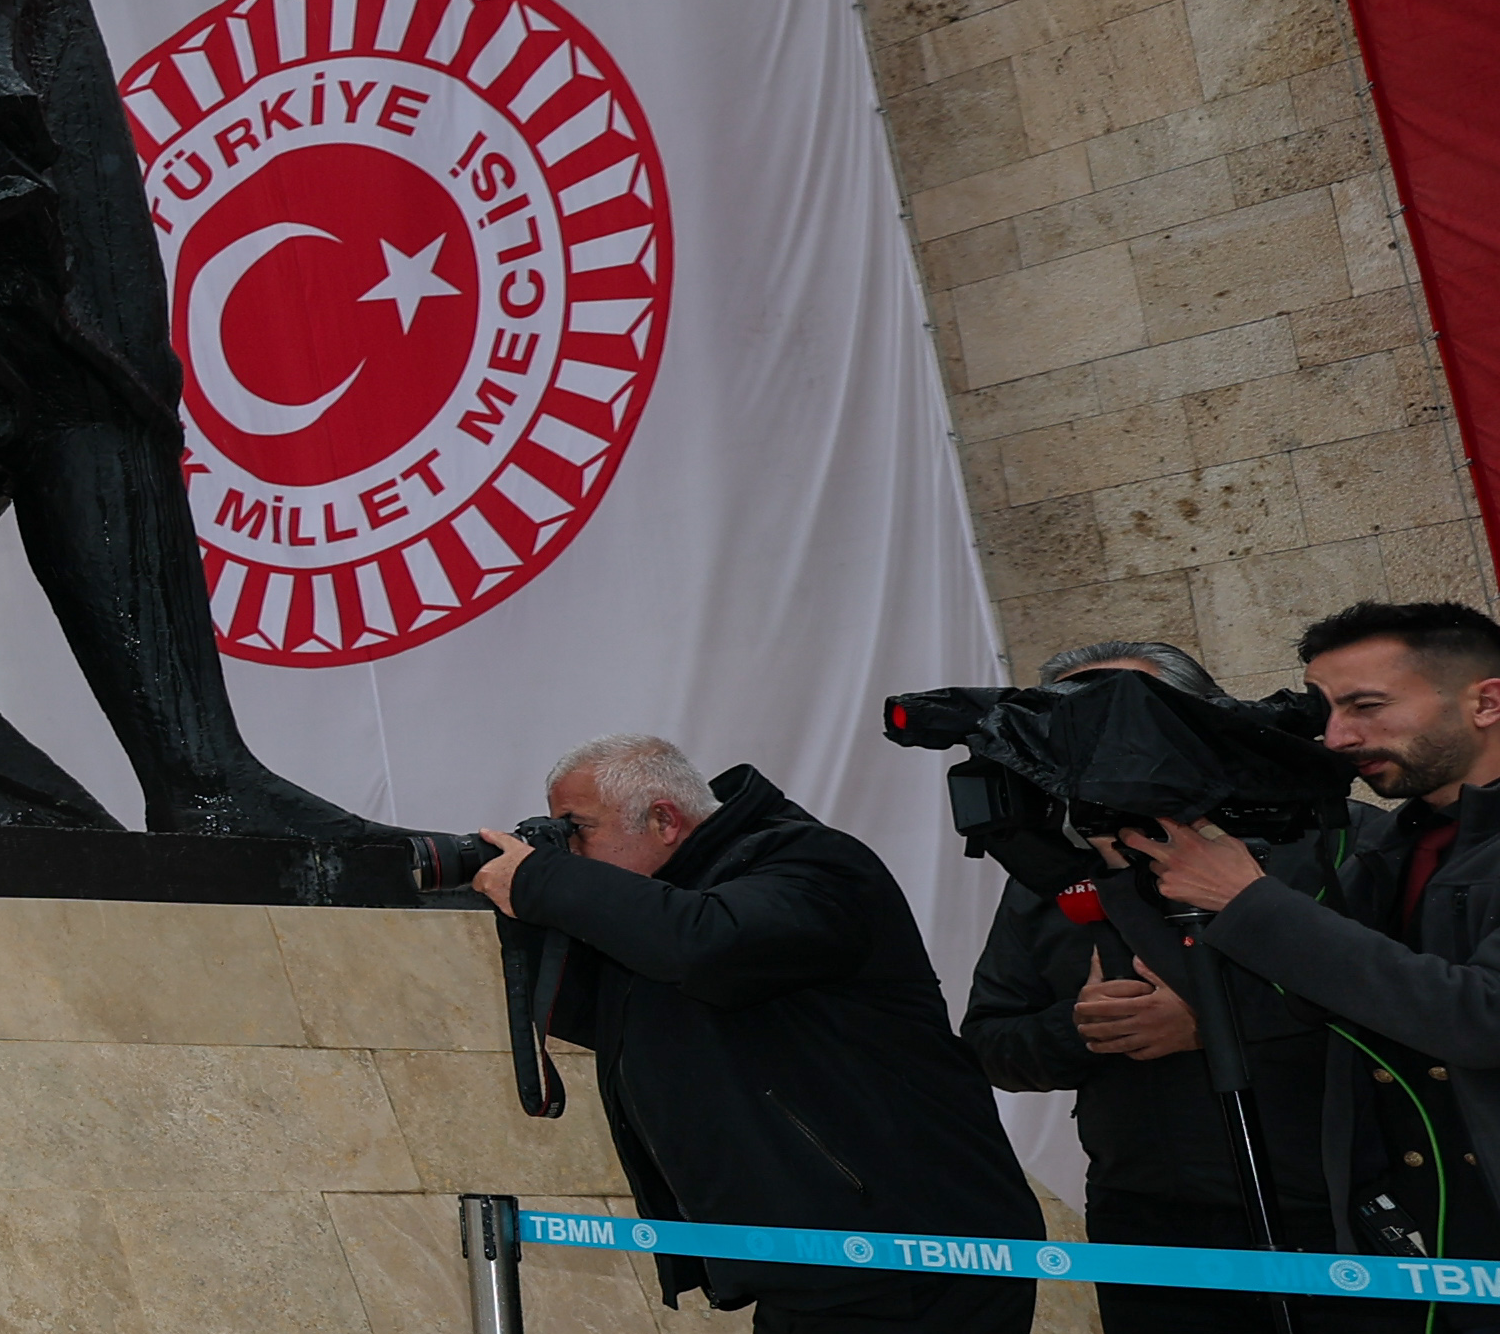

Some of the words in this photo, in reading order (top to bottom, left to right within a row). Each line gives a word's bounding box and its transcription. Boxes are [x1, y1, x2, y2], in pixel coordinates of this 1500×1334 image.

[151, 71, 431, 235] TÜRKİYE
[214, 447, 446, 547] MİLLET
[448, 130, 548, 446] MECLİSİ
[528, 1216, 615, 1245] TBMM
[893, 1238, 1013, 1272] TBMM
[1397, 1263, 1500, 1298] TBM
